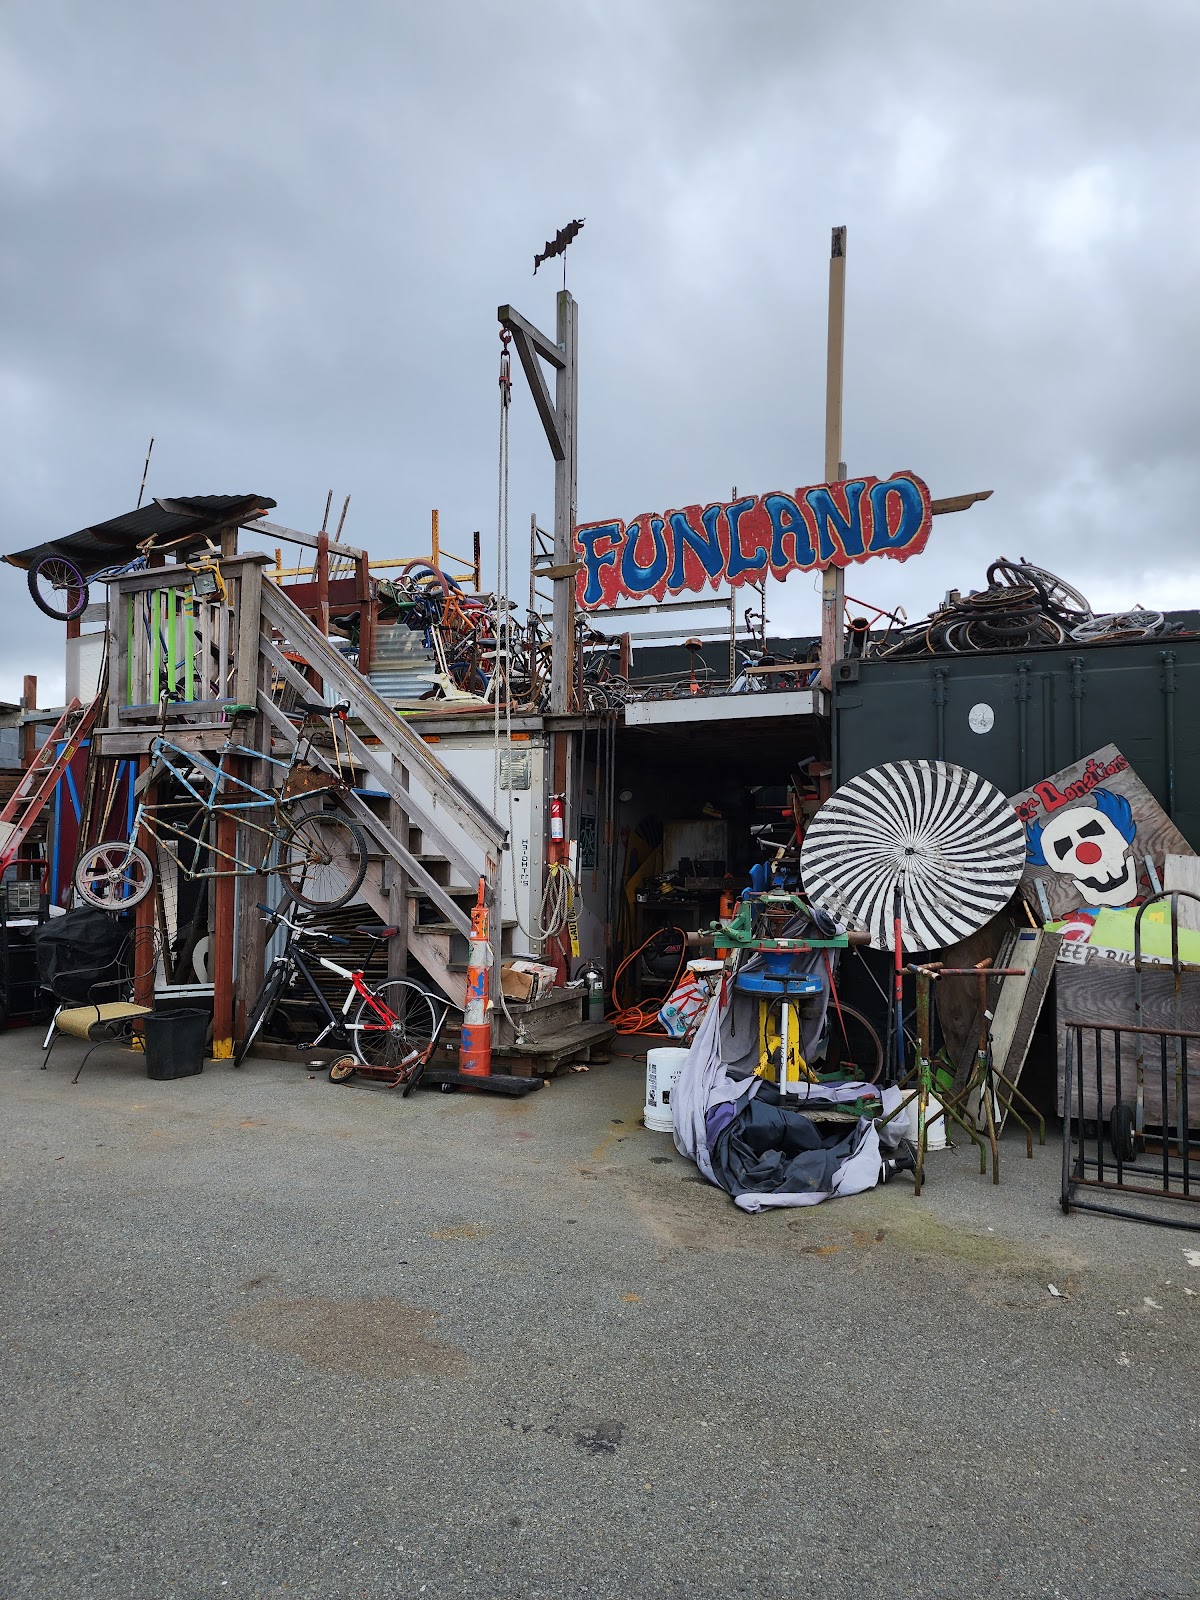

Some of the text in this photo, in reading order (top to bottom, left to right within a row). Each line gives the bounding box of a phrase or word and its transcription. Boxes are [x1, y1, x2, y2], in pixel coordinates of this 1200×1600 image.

[577, 476, 924, 605] FUNLAND
[1015, 754, 1129, 823] or Donations
[1058, 941, 1099, 964] EEP
